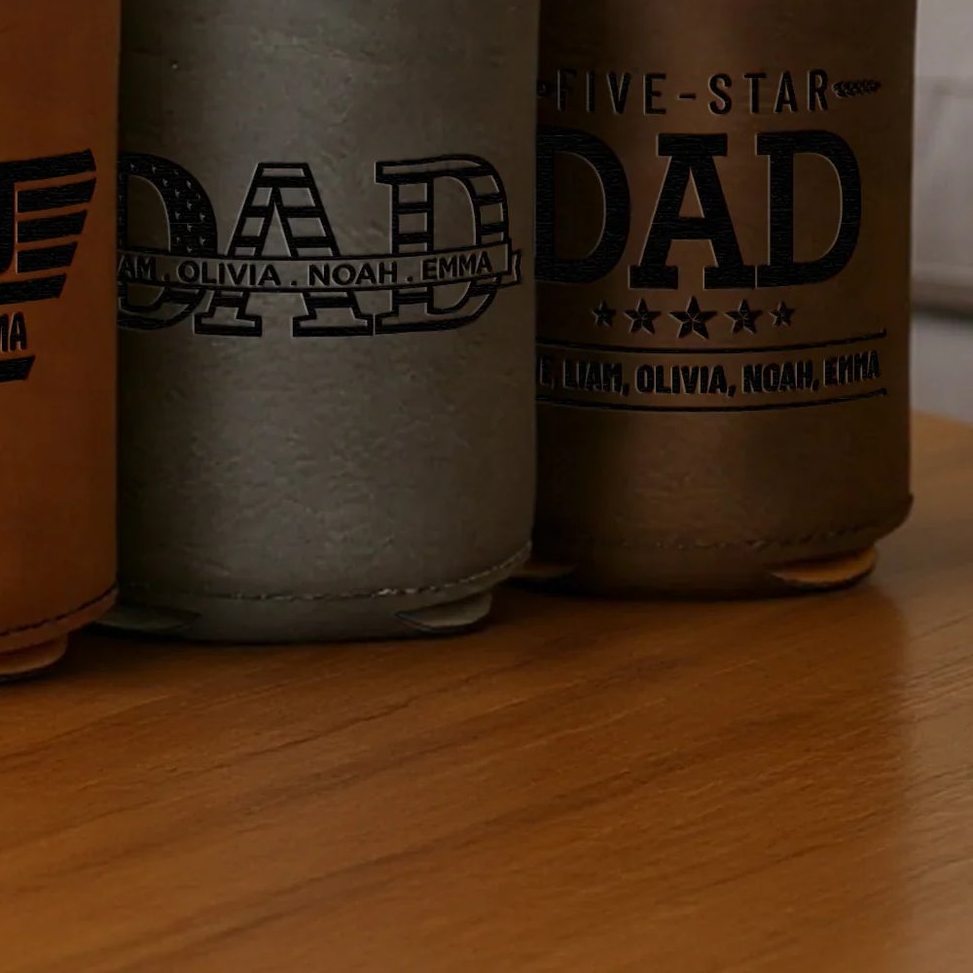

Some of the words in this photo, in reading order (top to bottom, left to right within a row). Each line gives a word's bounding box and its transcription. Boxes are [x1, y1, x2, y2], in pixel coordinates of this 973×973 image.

[557, 69, 829, 115] FIVE-STAR
[535, 129, 862, 290] DAD
[118, 152, 510, 337] DAD
[118, 254, 156, 282] AM
[178, 259, 281, 287] OLIVIA
[308, 262, 398, 286] NOAH
[421, 252, 492, 281] EMMA
[563, 358, 630, 397] LIAM,
[636, 363, 736, 398] OLIVIA,
[741, 359, 820, 394] NOAH,
[824, 350, 880, 387] EMMA
